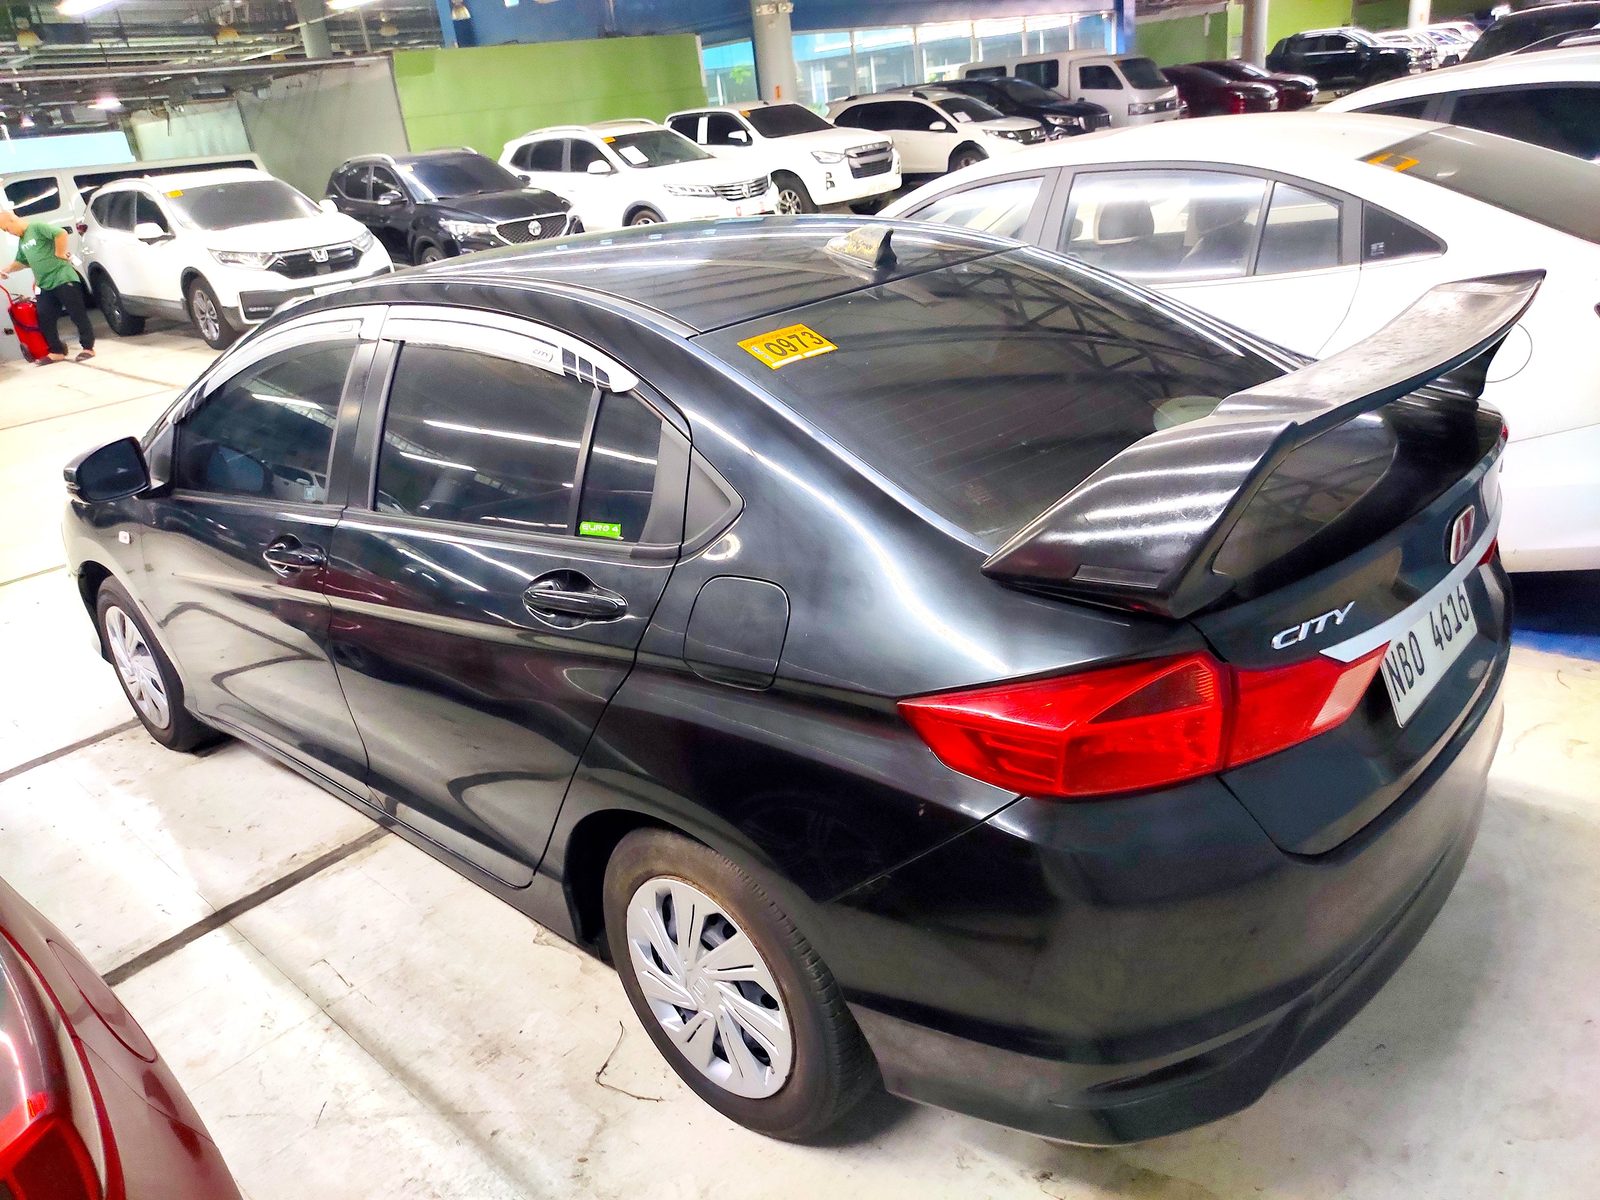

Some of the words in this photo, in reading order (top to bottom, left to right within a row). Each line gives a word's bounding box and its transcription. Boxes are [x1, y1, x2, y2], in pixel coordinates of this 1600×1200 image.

[763, 331, 824, 357] 0973
[582, 523, 610, 532] EURO
[1271, 600, 1356, 650] CITY
[1385, 631, 1425, 702] NBO
[1429, 585, 1470, 651] 4616
